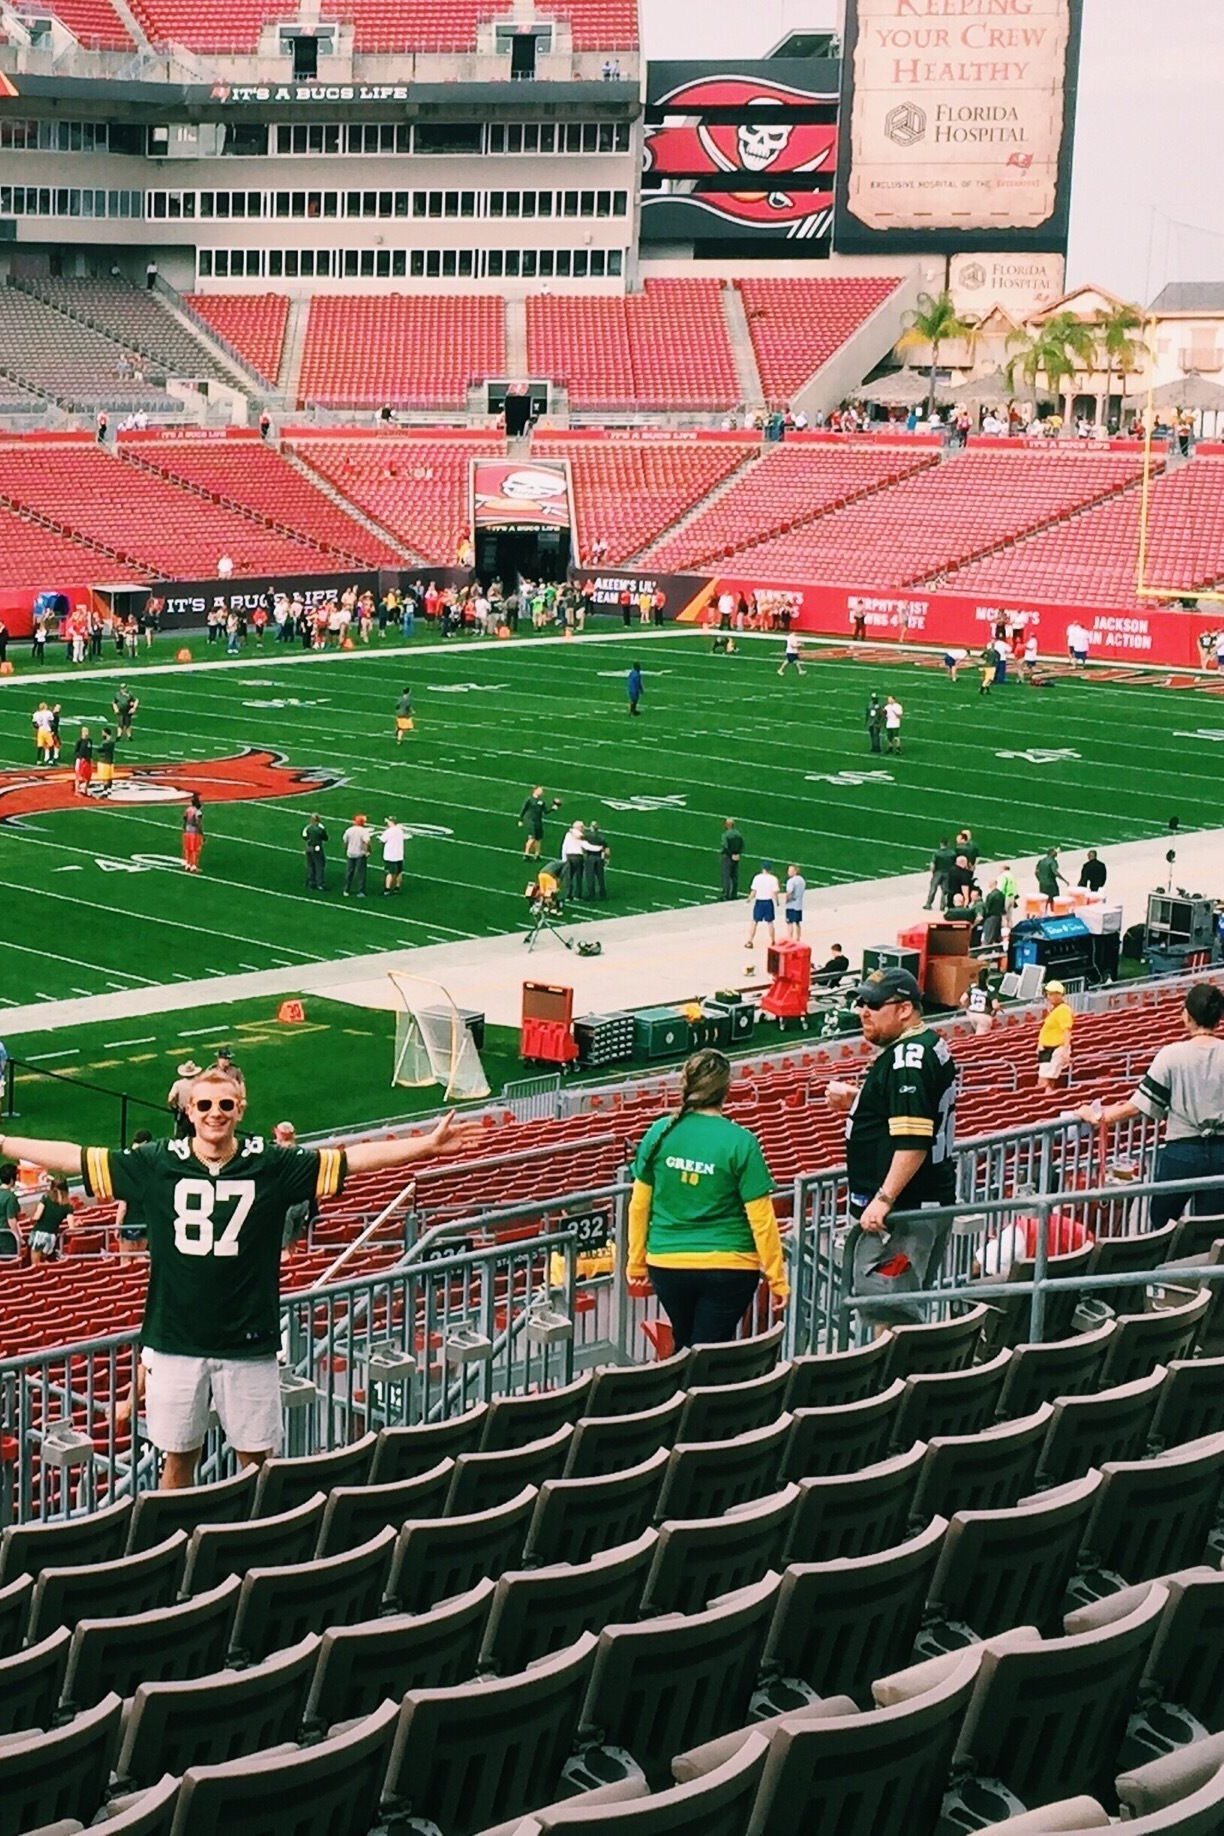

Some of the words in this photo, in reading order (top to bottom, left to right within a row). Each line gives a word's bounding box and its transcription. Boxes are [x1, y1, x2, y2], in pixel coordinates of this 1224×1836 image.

[892, 58, 1031, 83] HEALTHY
[231, 87, 270, 100] IT'S
[275, 88, 291, 100] A
[296, 87, 354, 100] BUCS
[359, 87, 408, 99] LIFE
[936, 104, 1019, 121] FLORIDA
[934, 126, 1029, 143] HOSPITAL
[961, 180, 972, 188] OF
[993, 264, 1047, 276] FLORIDA
[992, 277, 1050, 289] HOSPITAL
[167, 598, 206, 613] IT'S
[213, 596, 225, 609] A
[590, 591, 619, 604] REAM
[1094, 616, 1149, 633] JACKSON
[1105, 632, 1153, 649] ACTION
[893, 1043, 924, 1070] 12
[666, 1156, 715, 1175] GREEN
[173, 1177, 256, 1256] 87
